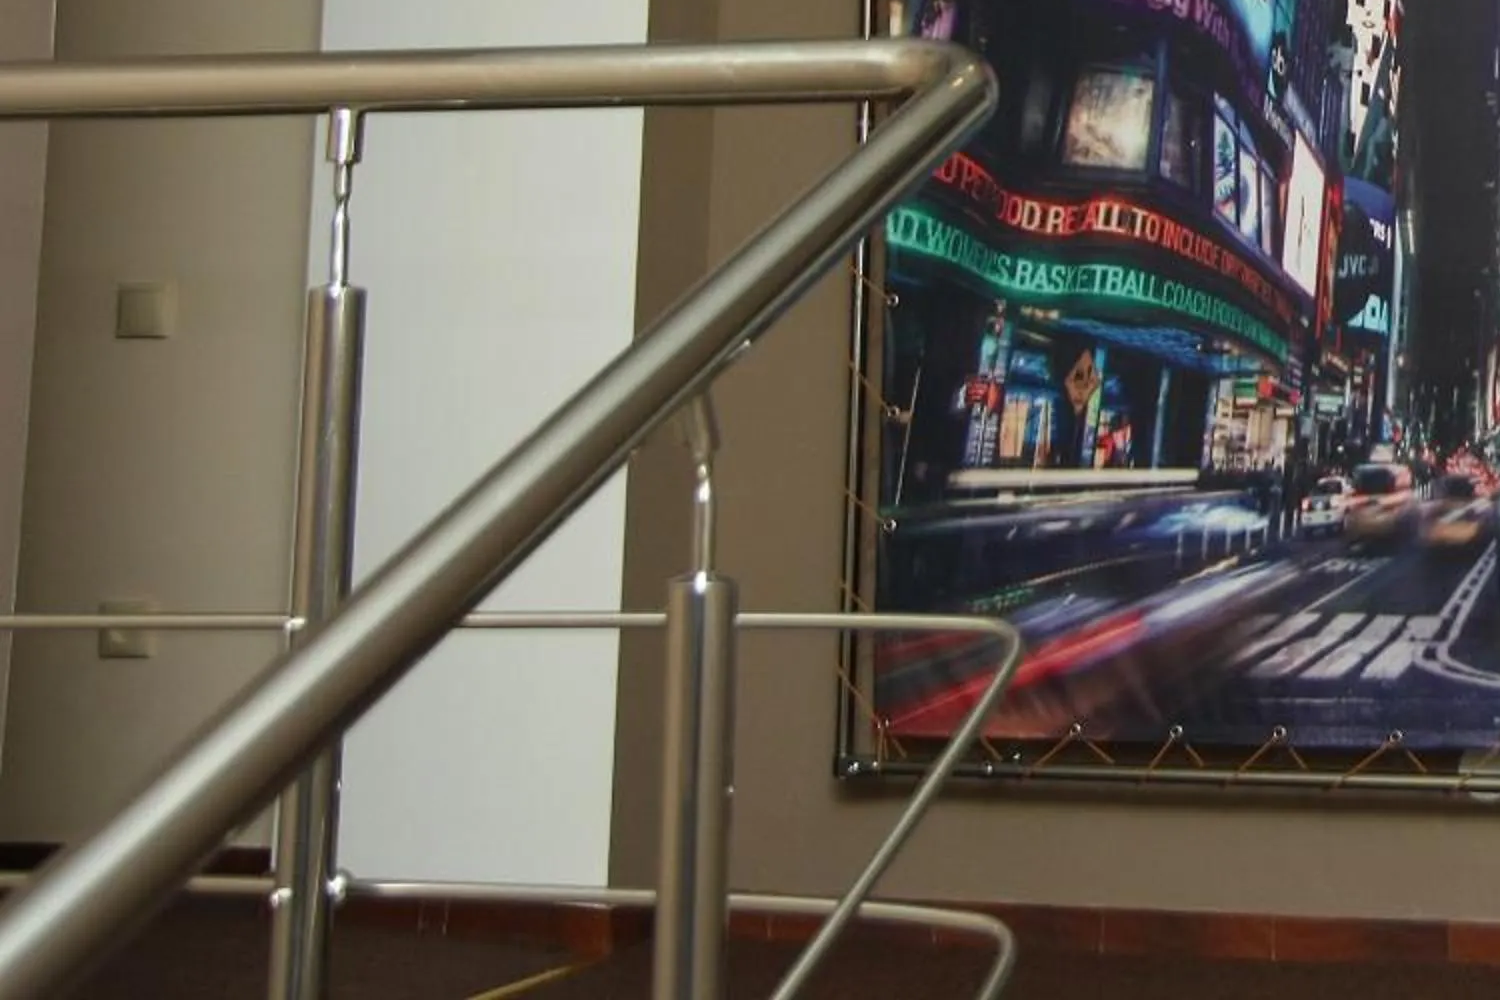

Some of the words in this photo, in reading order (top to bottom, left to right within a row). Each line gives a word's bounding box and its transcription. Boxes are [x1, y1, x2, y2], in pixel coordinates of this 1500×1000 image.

[1130, 207, 1160, 242] TO
[1014, 258, 1158, 303] BASKETBALL
[1162, 279, 1212, 323] COACH
